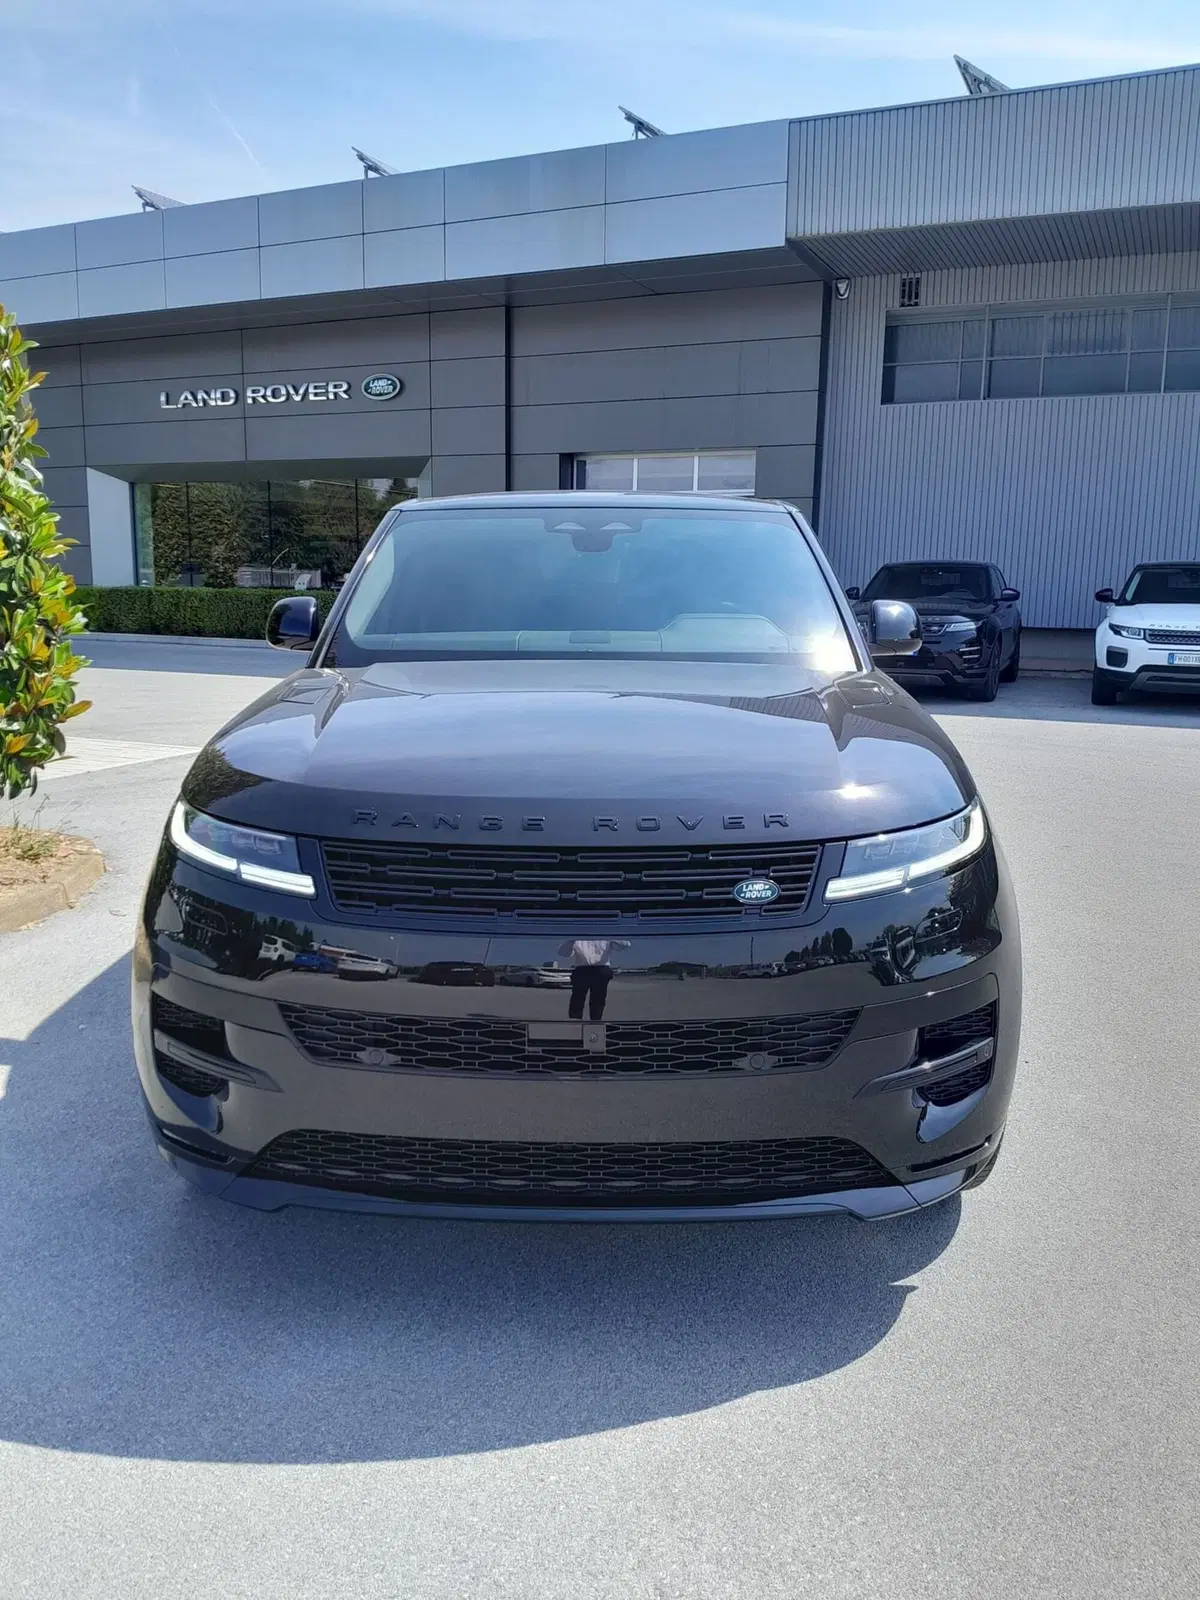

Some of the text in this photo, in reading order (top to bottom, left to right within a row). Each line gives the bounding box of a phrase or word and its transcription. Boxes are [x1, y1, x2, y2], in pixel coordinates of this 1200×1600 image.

[370, 379, 388, 387] LAND
[370, 385, 394, 394] ROVER
[160, 381, 350, 408] LAND ROVER
[352, 808, 790, 832] RANGE ROVER
[742, 883, 765, 891] LAND
[745, 890, 772, 899] ROVER
